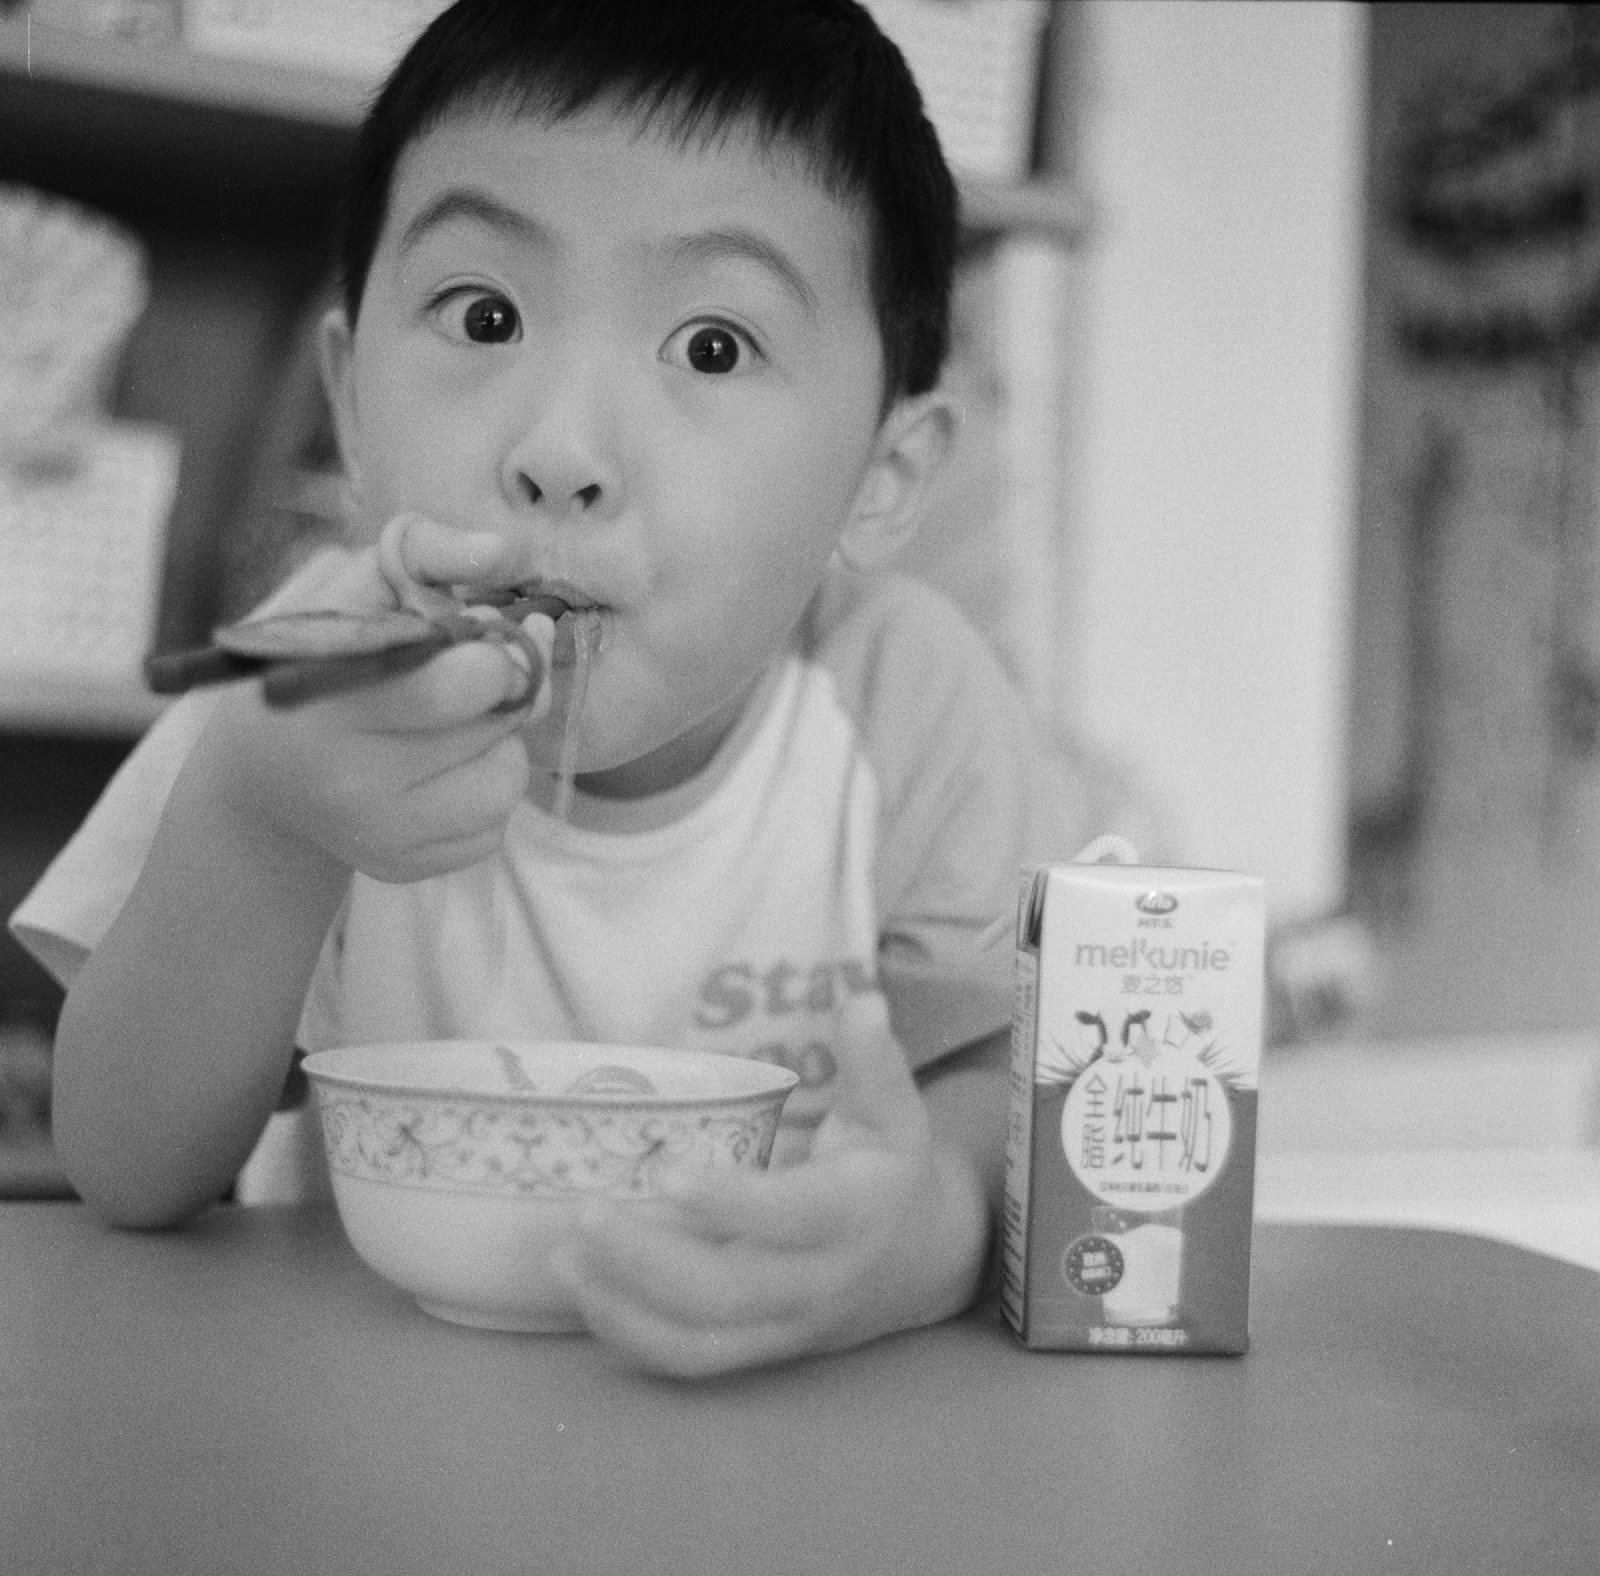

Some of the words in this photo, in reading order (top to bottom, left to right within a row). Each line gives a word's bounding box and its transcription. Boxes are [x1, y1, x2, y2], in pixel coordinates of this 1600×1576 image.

[1074, 938, 1230, 971] melkunie
[1112, 1072, 1212, 1174] 纯牛奶
